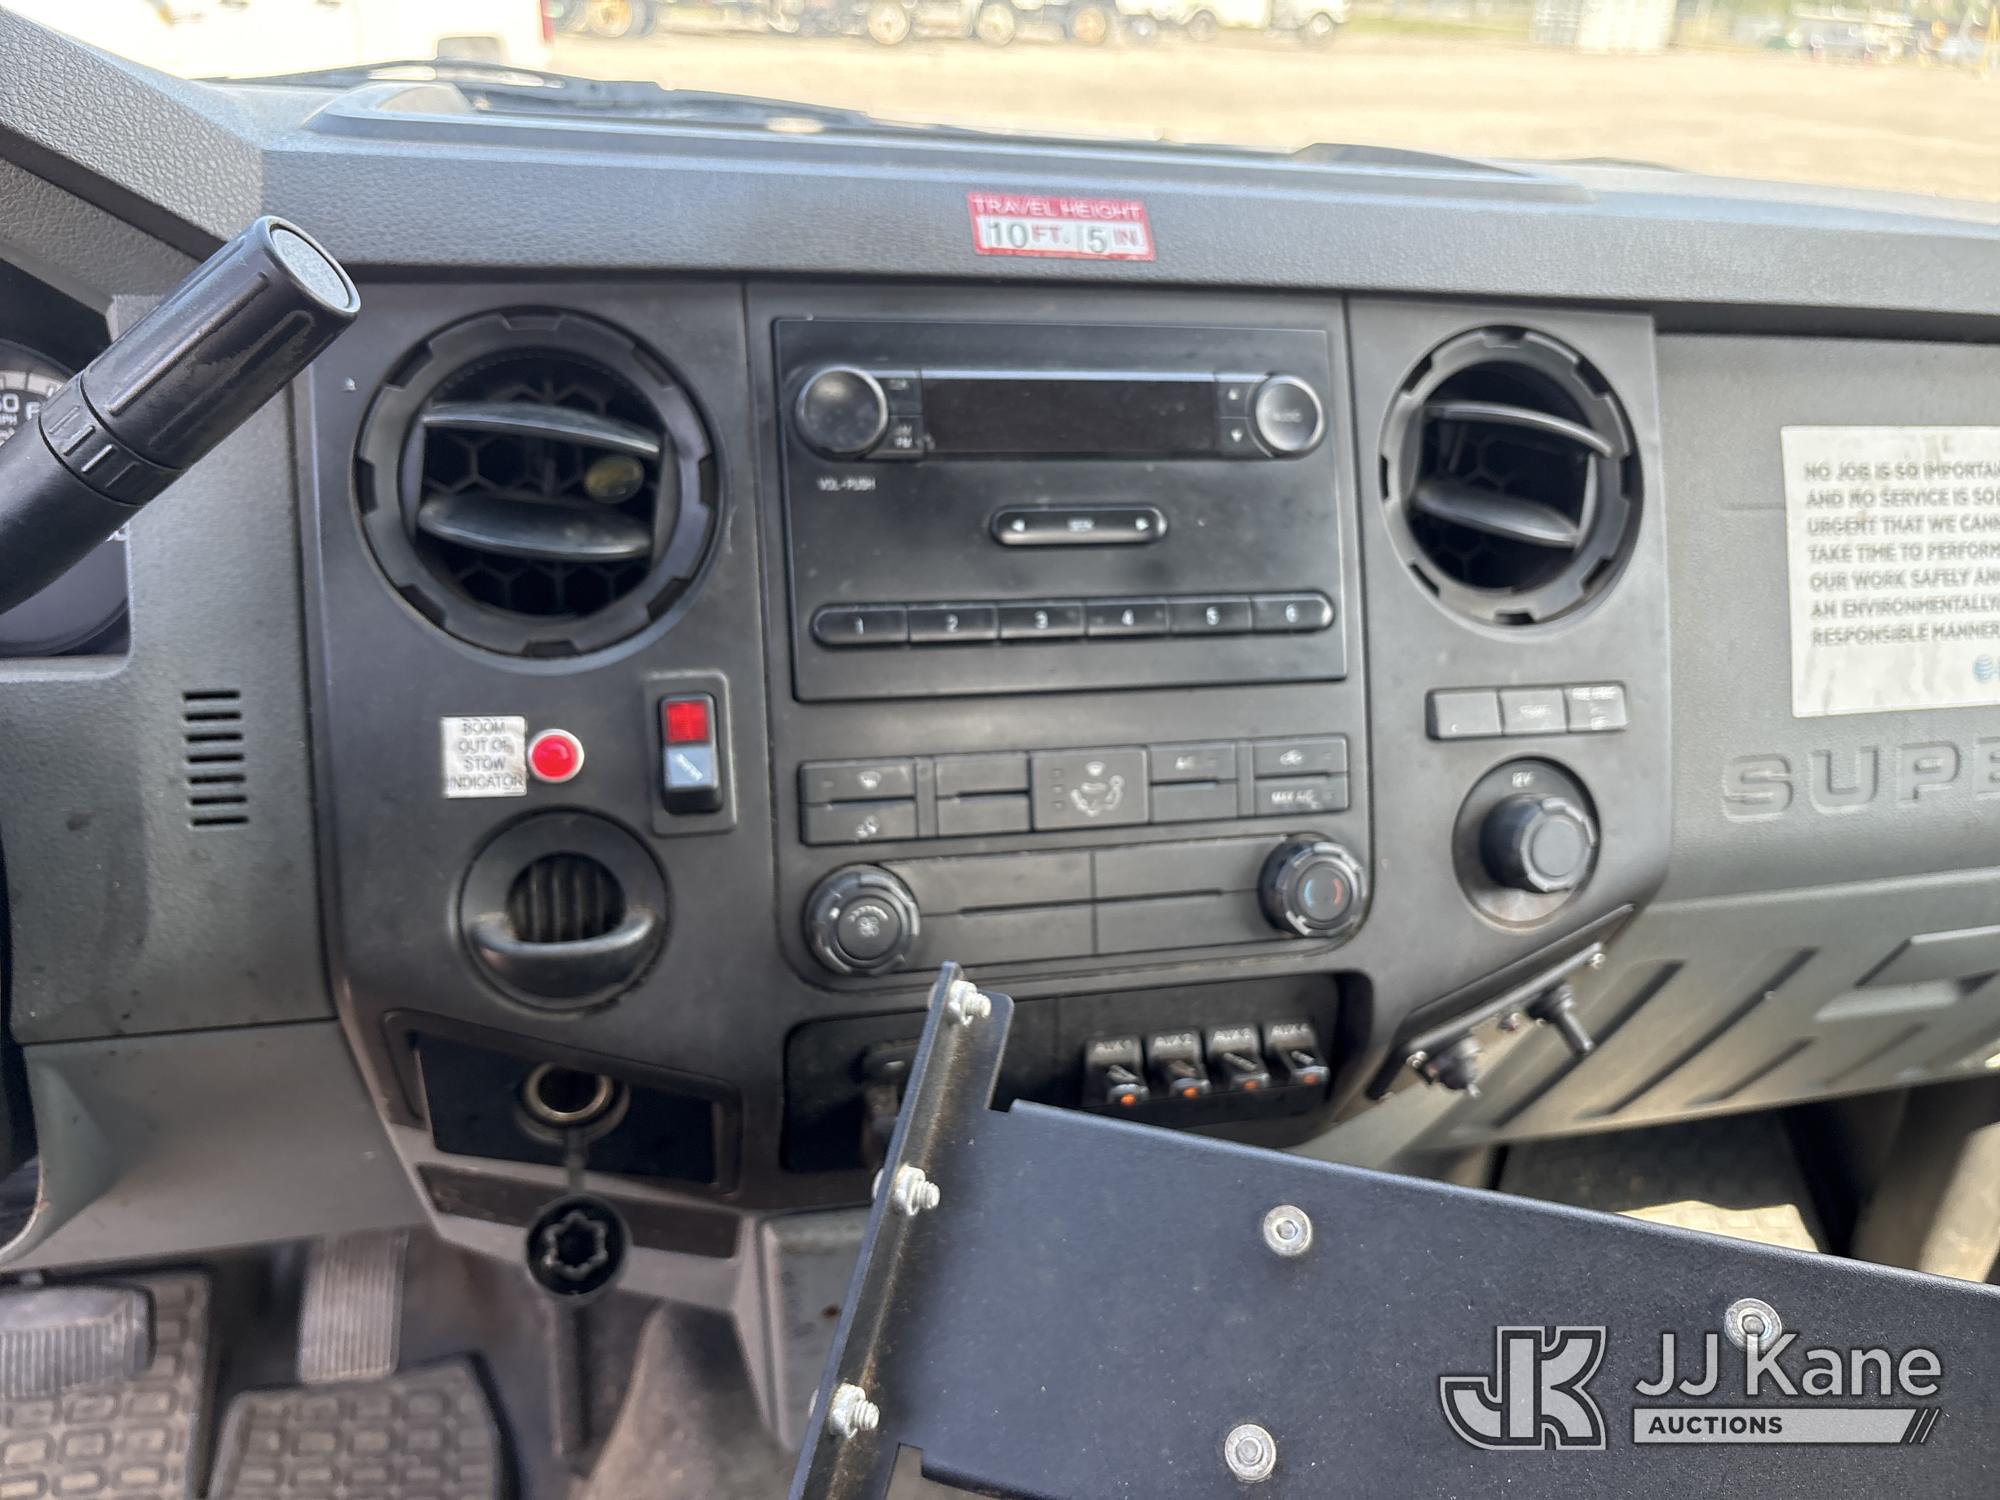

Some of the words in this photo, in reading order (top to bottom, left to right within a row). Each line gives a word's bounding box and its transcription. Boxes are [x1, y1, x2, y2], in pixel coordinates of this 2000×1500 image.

[972, 197, 1055, 216] TRAVEL
[1060, 203, 1141, 220] HEIGHT
[989, 222, 1027, 248] 10
[1112, 229, 1139, 248] IN
[1805, 463, 1830, 482] NO
[1837, 463, 1871, 481] JOB
[1875, 462, 1892, 480] IS
[1895, 462, 1918, 480] SO
[1806, 490, 1843, 509] AND
[1849, 489, 1875, 508] NO
[1880, 487, 1950, 507] SERVICE
[1953, 487, 1969, 506] IS
[1807, 516, 1876, 536] URGENT
[1882, 515, 1924, 533] THAT
[1928, 514, 1956, 533] WE
[1808, 544, 1853, 563] TAKE
[1857, 543, 1897, 562] TIME
[1901, 543, 1924, 561] TO
[1810, 572, 1848, 591] OUR
[1851, 570, 1906, 588] WORK
[1911, 568, 1969, 587] SAFELY
[1811, 599, 1837, 618] AN
[855, 616, 864, 635] 1
[947, 613, 959, 633] 2
[1034, 609, 1049, 630] 3
[1121, 608, 1135, 627] 4
[1812, 623, 1929, 645] RESPONSIBLE
[462, 719, 505, 735] BOOM
[458, 738, 487, 753] OUT
[464, 756, 506, 772] STOW
[449, 774, 524, 789] INDICATOR
